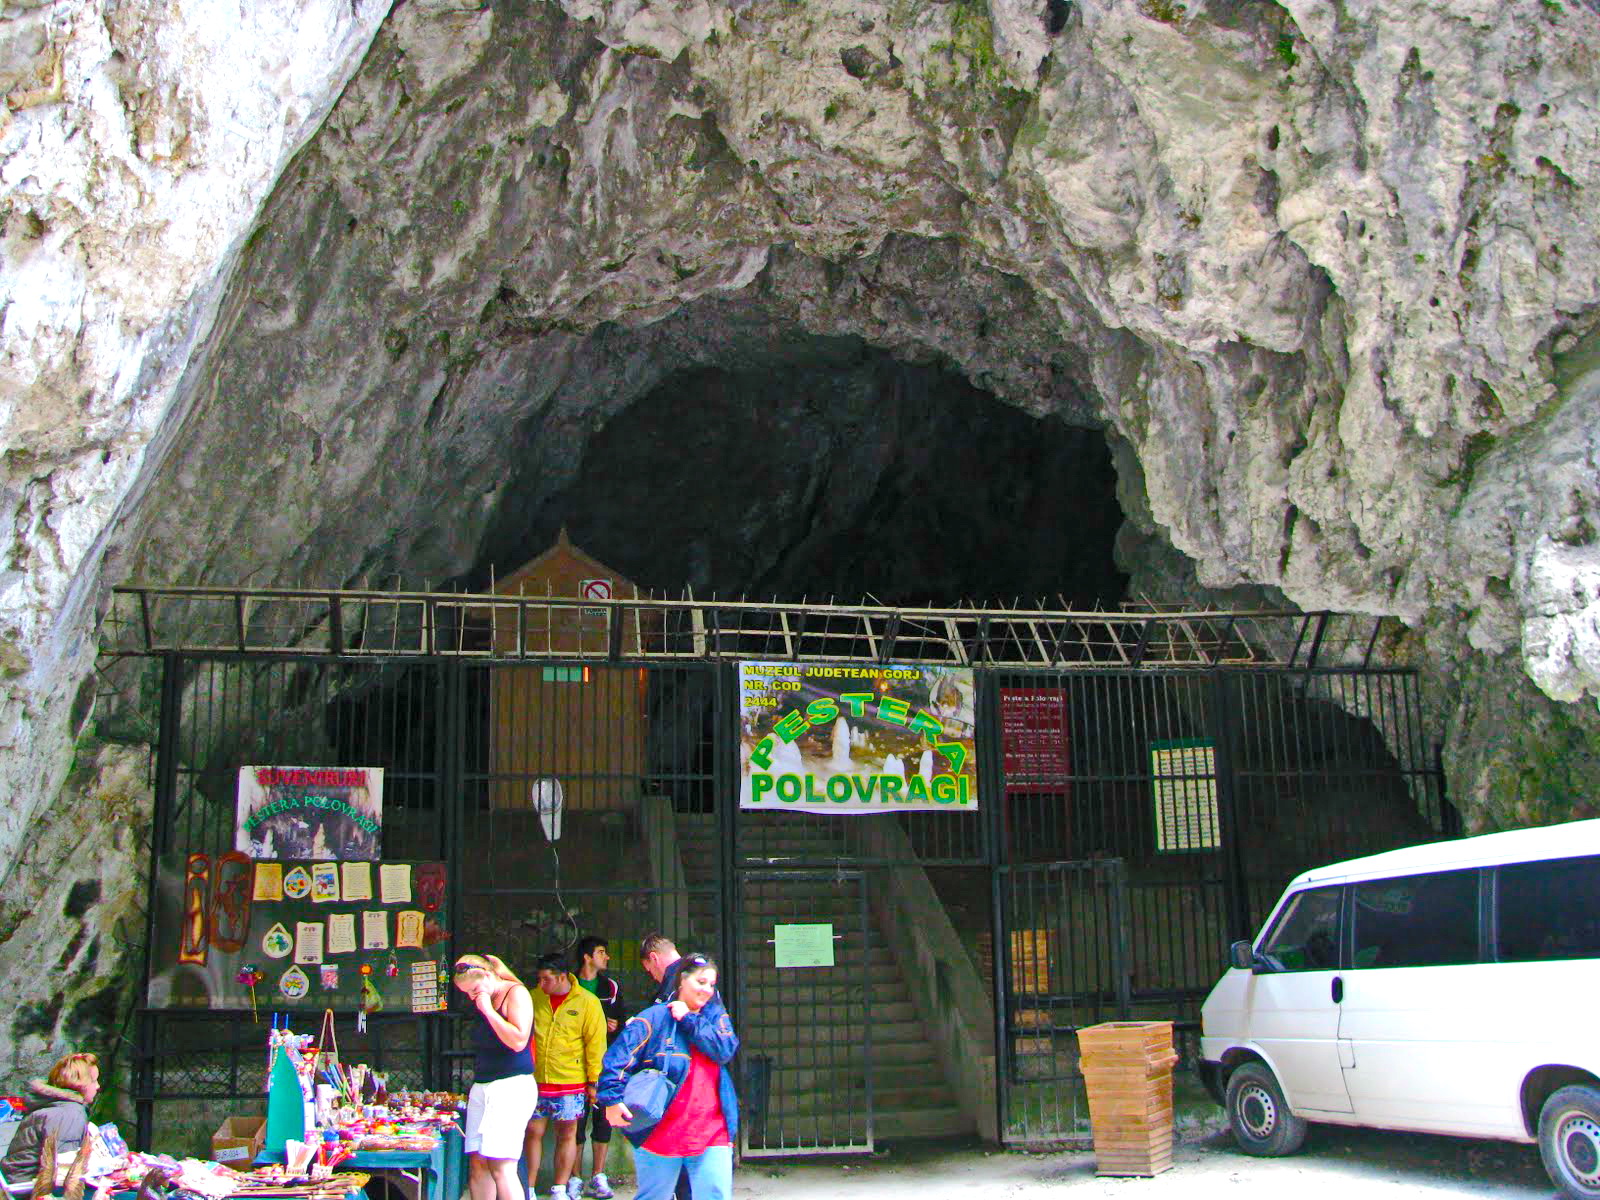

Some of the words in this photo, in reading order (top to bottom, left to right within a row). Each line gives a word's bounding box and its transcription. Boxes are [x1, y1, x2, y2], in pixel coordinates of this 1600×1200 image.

[743, 665, 801, 677] MUZEUL
[806, 667, 879, 679] JUDETEAN
[883, 669, 920, 680] GORJ
[744, 680, 769, 691] NR.
[771, 681, 802, 692] COD
[743, 697, 778, 707] 2444
[750, 692, 968, 775] PESTERA
[750, 772, 970, 806] POLOVRAGI
[303, 795, 382, 833] POLOVRAGI
